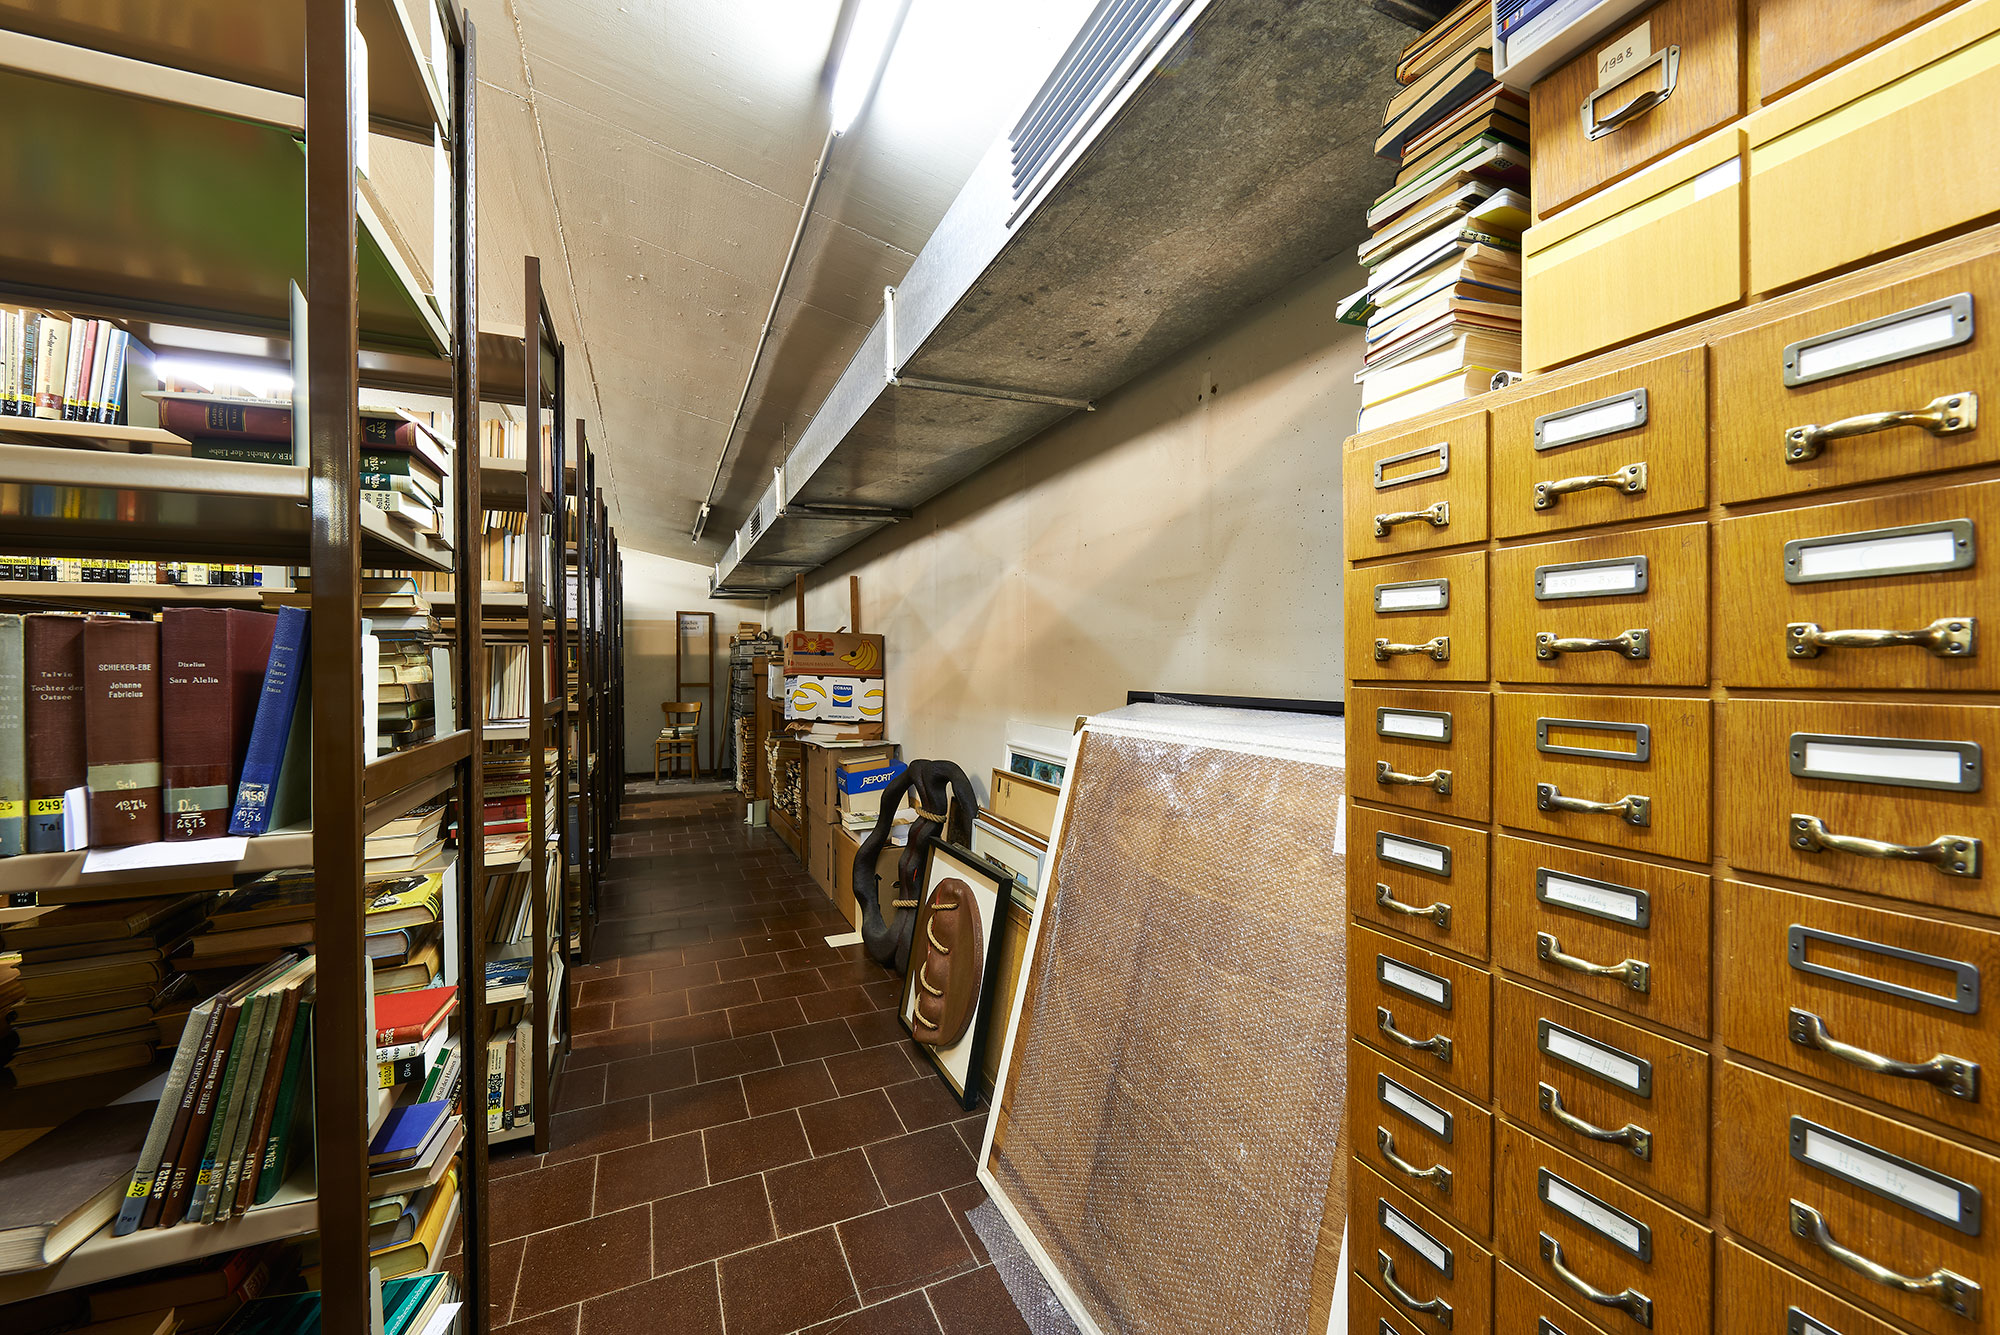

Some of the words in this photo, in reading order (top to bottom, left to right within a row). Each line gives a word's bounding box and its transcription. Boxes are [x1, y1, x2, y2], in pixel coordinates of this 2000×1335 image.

[1599, 46, 1633, 74] 1998
[247, 451, 270, 459] Macht
[793, 633, 834, 652] Dole
[169, 676, 188, 684] Sara
[30, 684, 66, 692] Tochter
[110, 682, 142, 690] Johanne
[40, 694, 72, 702] Ostsee
[108, 691, 144, 699] Fabricius
[860, 770, 896, 788] REPORT
[116, 779, 137, 790] Sch
[240, 790, 265, 802] 1958
[40, 820, 62, 832] Tal
